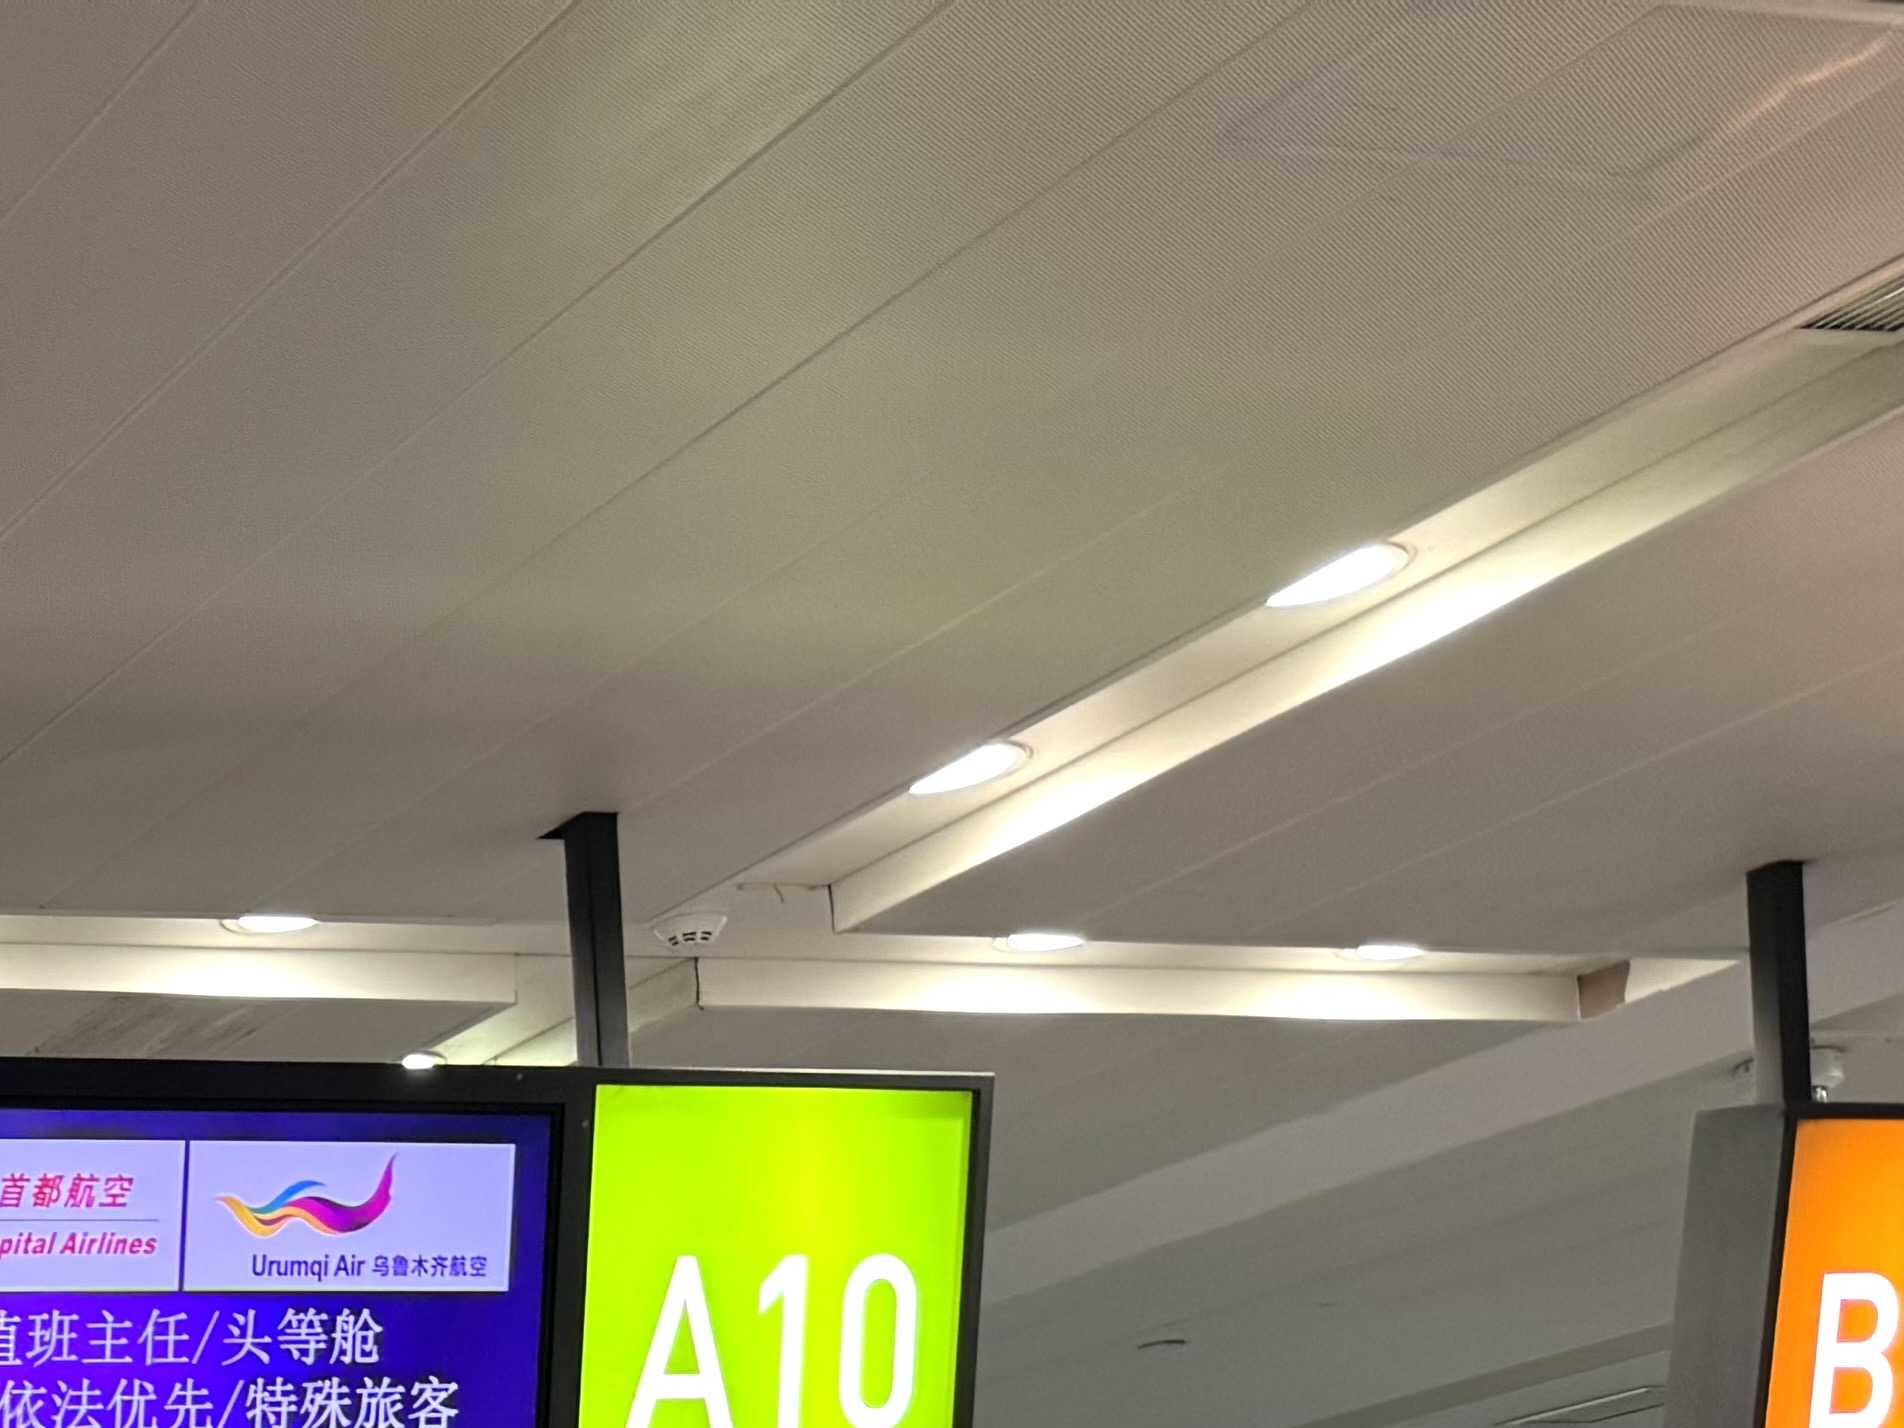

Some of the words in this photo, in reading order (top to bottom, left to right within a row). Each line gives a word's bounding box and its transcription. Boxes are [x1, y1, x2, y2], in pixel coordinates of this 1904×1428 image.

[60, 1231, 158, 1256] Airlines
[252, 1253, 331, 1282] Urumqi
[334, 1254, 365, 1278] Air
[371, 1255, 488, 1278] 乌鲁木齐航空
